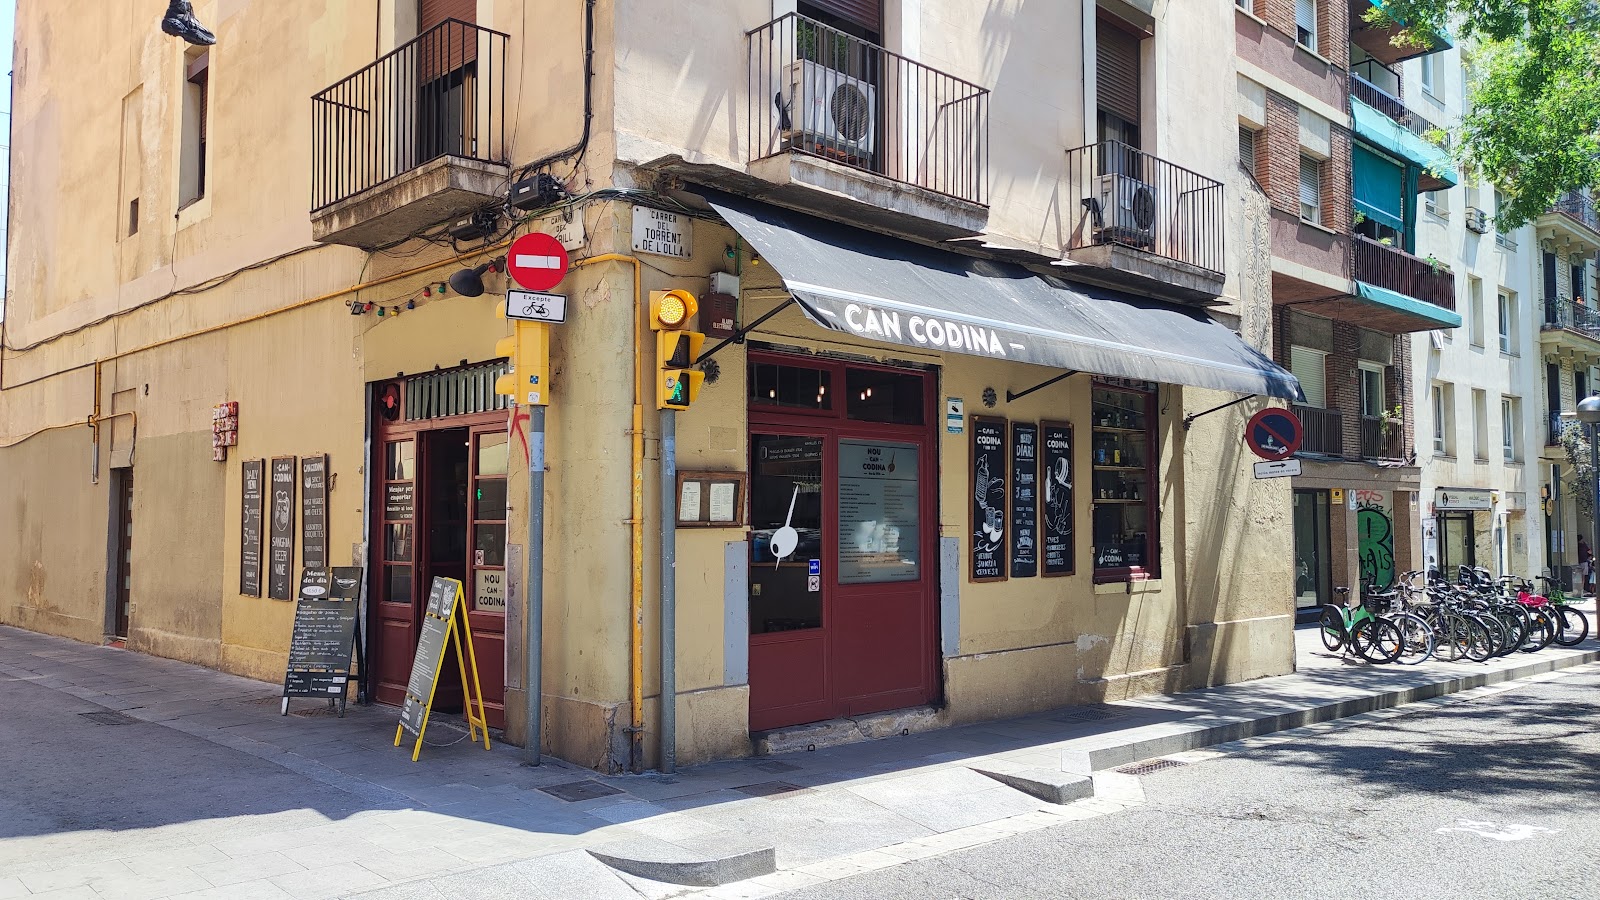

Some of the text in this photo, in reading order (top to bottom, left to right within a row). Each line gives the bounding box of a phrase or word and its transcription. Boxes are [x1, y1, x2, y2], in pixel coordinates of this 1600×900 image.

[651, 211, 677, 223] CARRER
[657, 221, 669, 231] DEL
[645, 228, 682, 245] TORRENT
[642, 239, 684, 257] DE L'OLLA
[523, 294, 551, 303] Excepte
[844, 303, 1007, 357] CAN CODINA
[976, 435, 1002, 446] CODINA
[1046, 439, 1069, 449] CODINA
[867, 447, 881, 456] NOU
[1016, 444, 1034, 458] DIARI
[862, 463, 886, 471] CODINA
[273, 473, 293, 483] CODINA
[274, 549, 288, 562] BEER
[274, 563, 286, 576] WINE
[484, 574, 500, 584] NOU
[486, 586, 498, 594] CAN
[479, 596, 506, 607] CODINA
